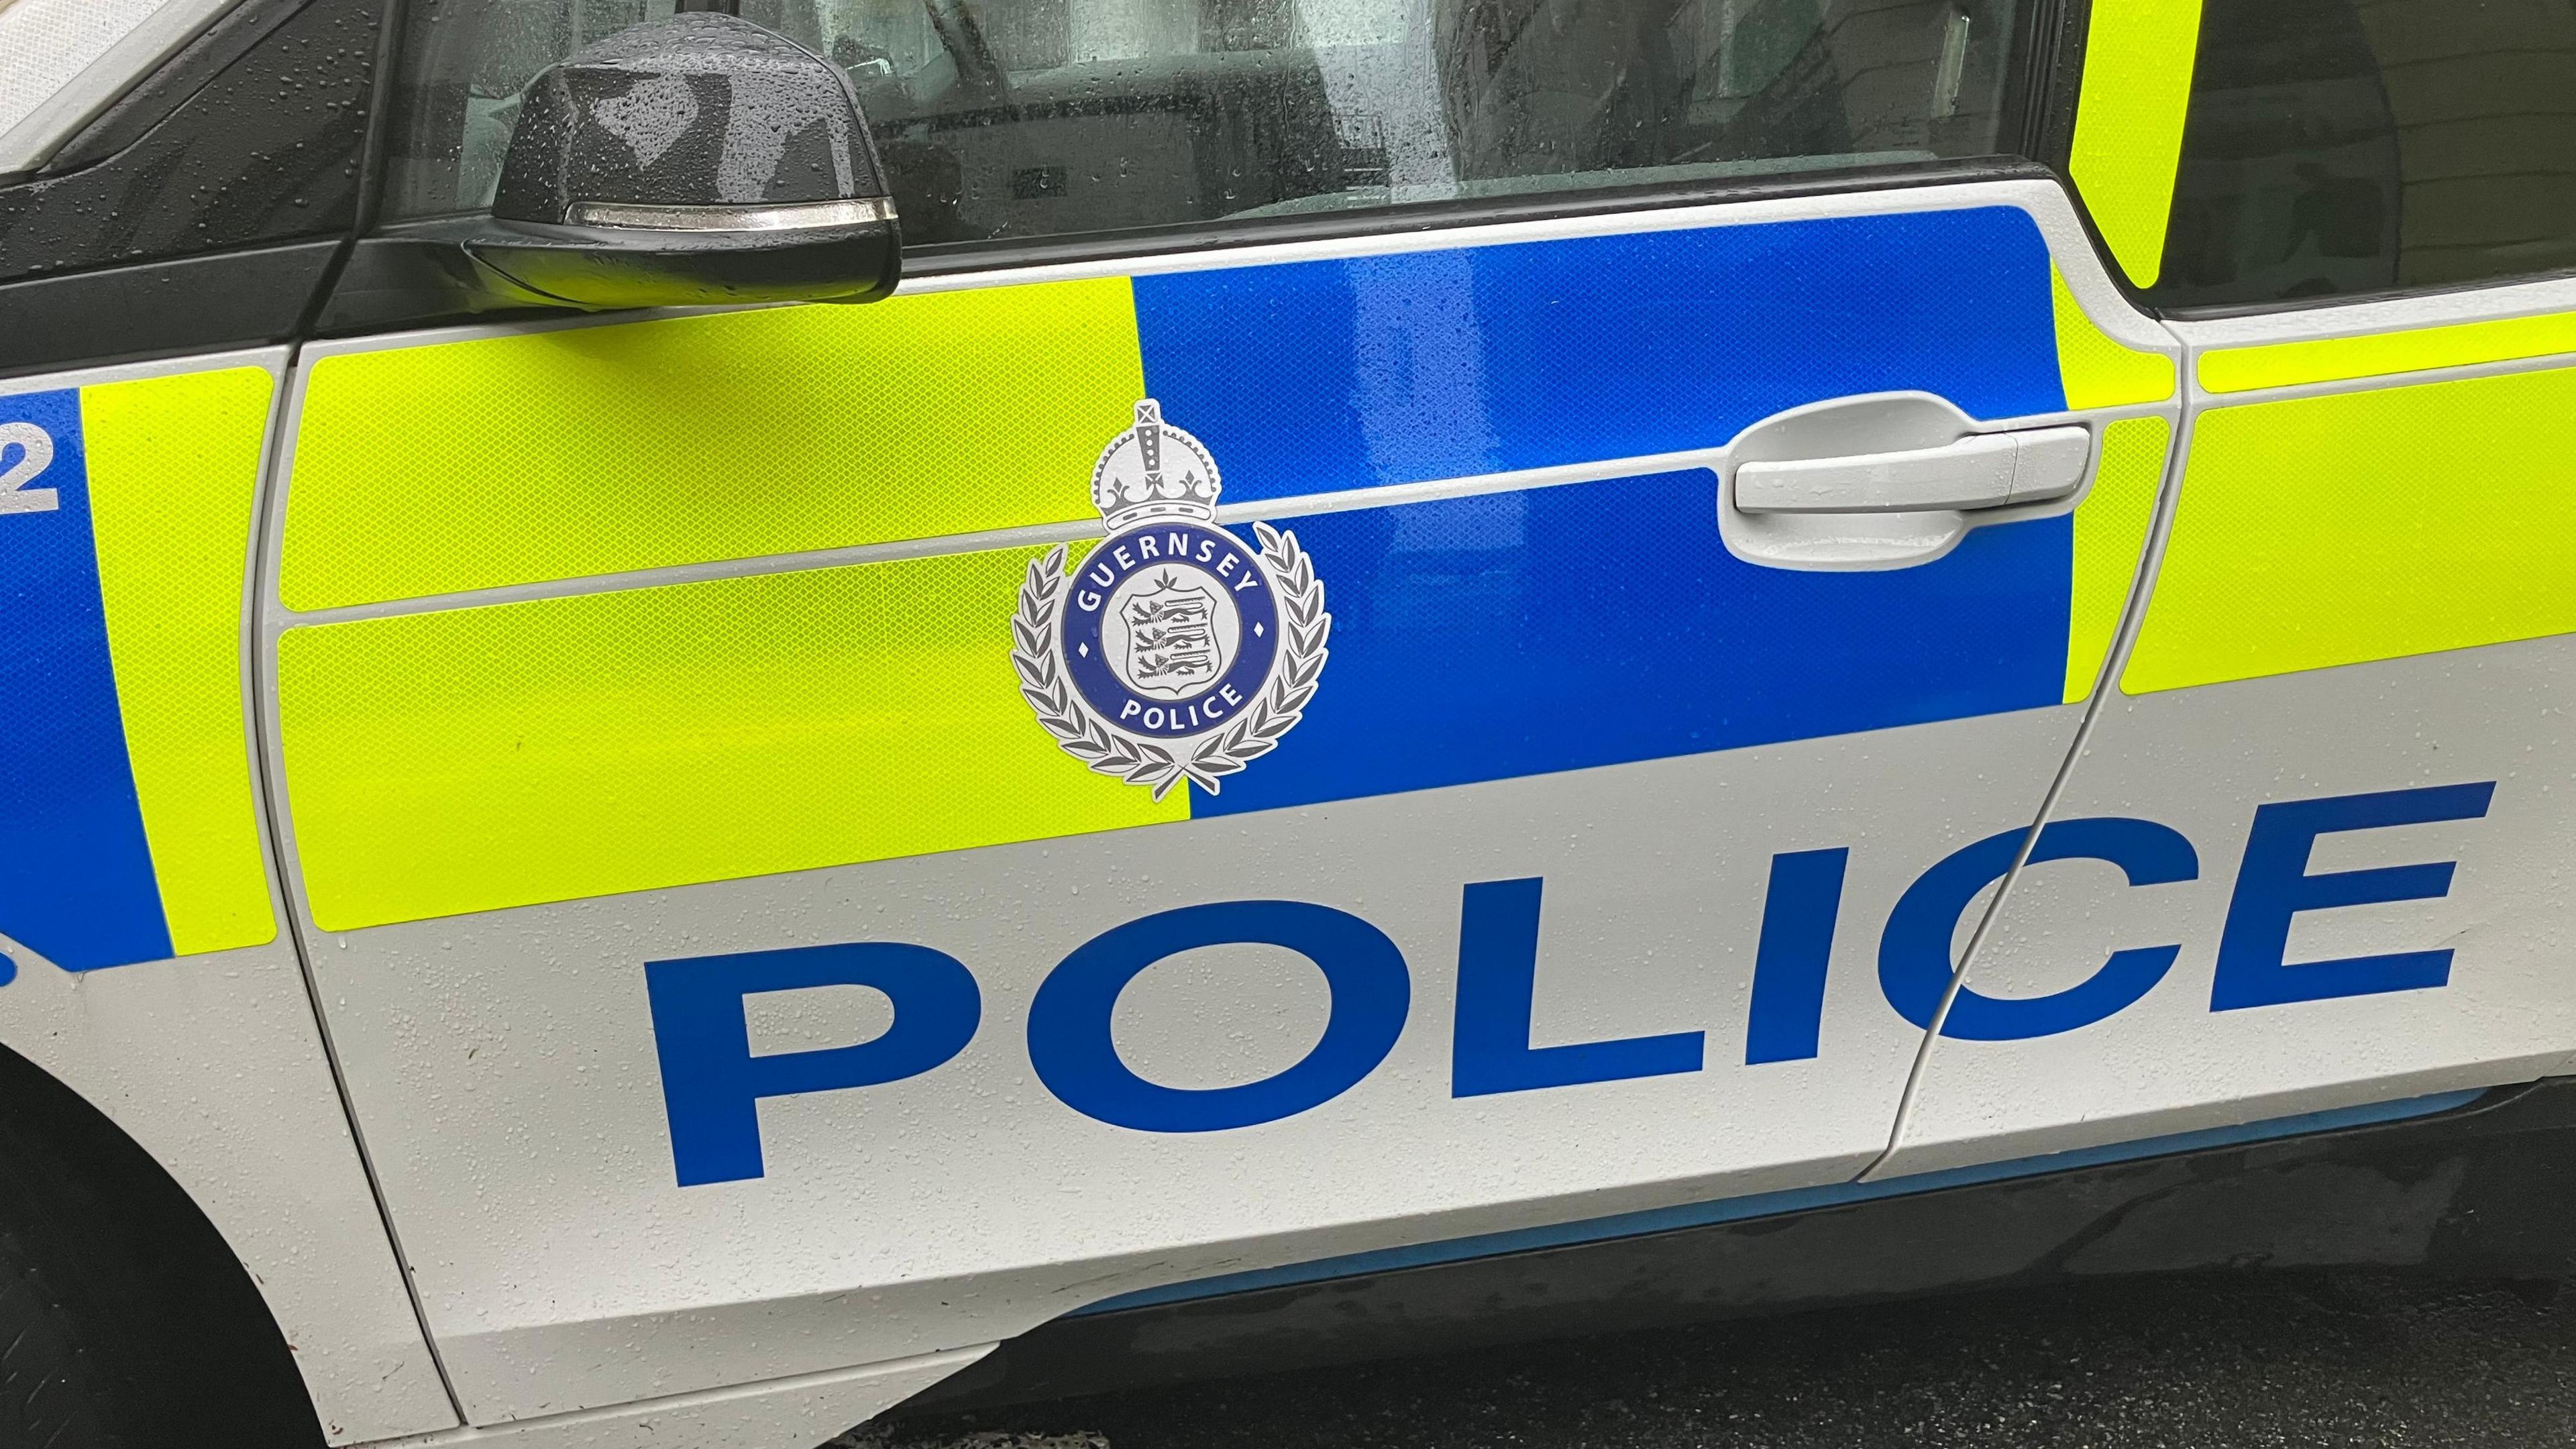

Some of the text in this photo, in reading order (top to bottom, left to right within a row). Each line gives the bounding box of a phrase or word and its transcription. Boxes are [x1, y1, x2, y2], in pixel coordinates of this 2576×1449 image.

[1077, 532, 1258, 612] GUERNSEY
[1120, 683, 1243, 730] POLICE
[645, 783, 2493, 1187] POLICE
